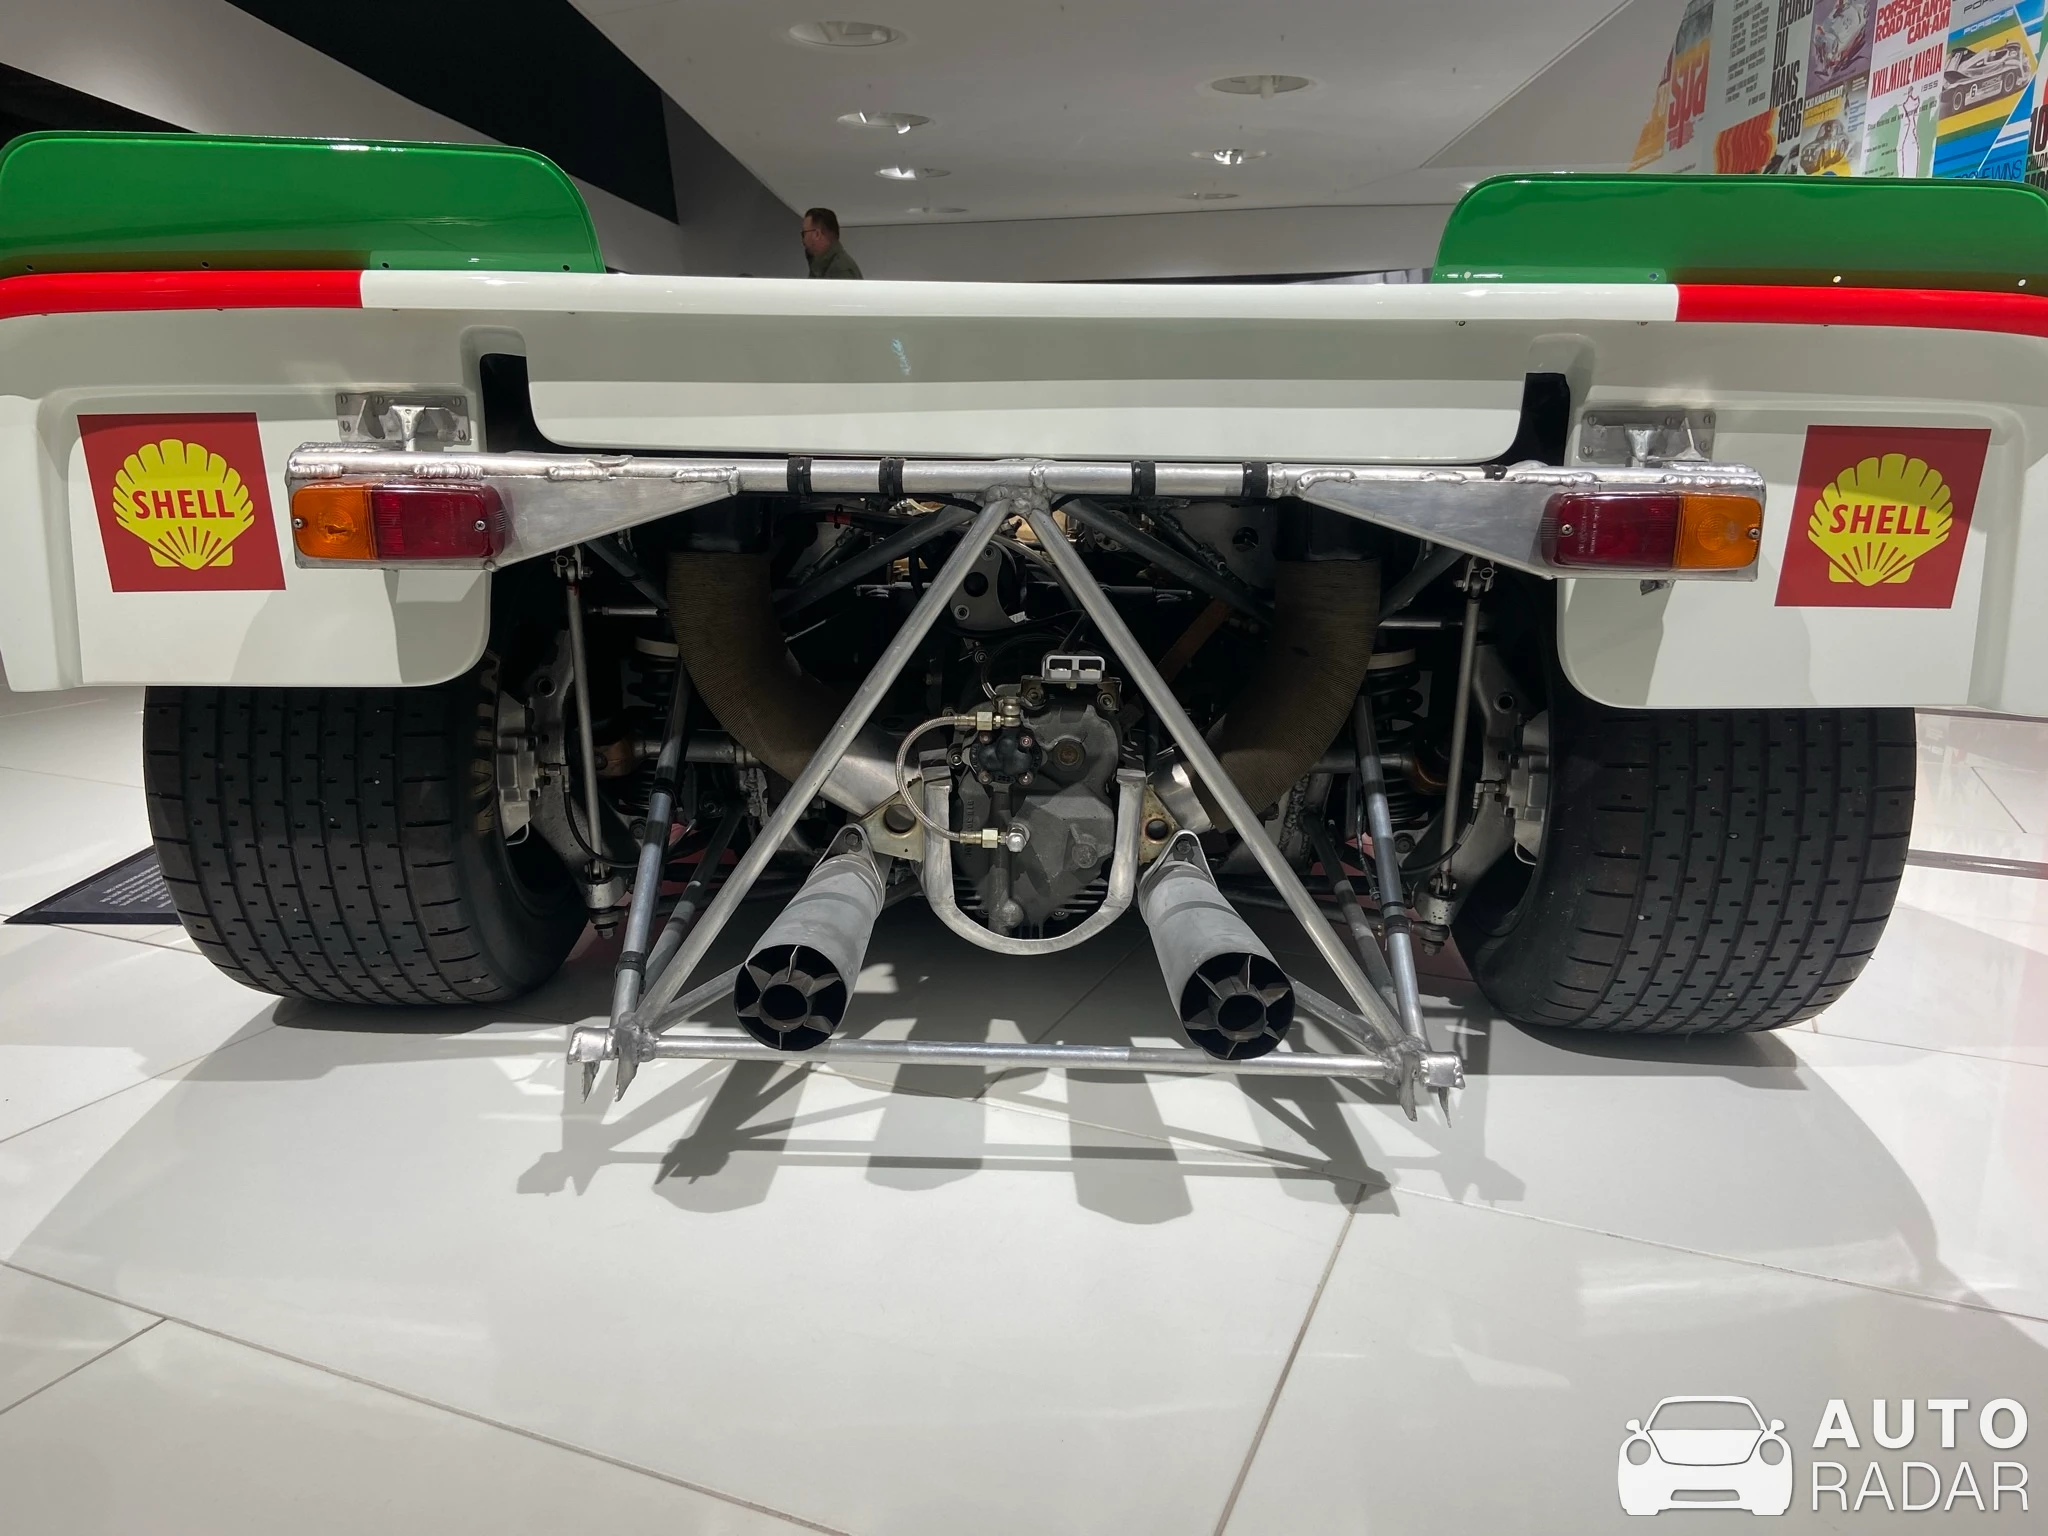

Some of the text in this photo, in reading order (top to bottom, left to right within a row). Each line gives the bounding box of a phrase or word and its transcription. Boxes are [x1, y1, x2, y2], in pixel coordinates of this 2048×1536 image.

[1875, 15, 1903, 43] ROAD
[1773, 27, 1789, 71] DU
[1912, 43, 1944, 83] MIGLIA
[1769, 60, 1800, 110] MANS
[1921, 80, 1939, 92] 1955
[1777, 97, 1804, 145] 1966
[132, 489, 235, 519] SHELL
[1829, 503, 1931, 535] SHELL
